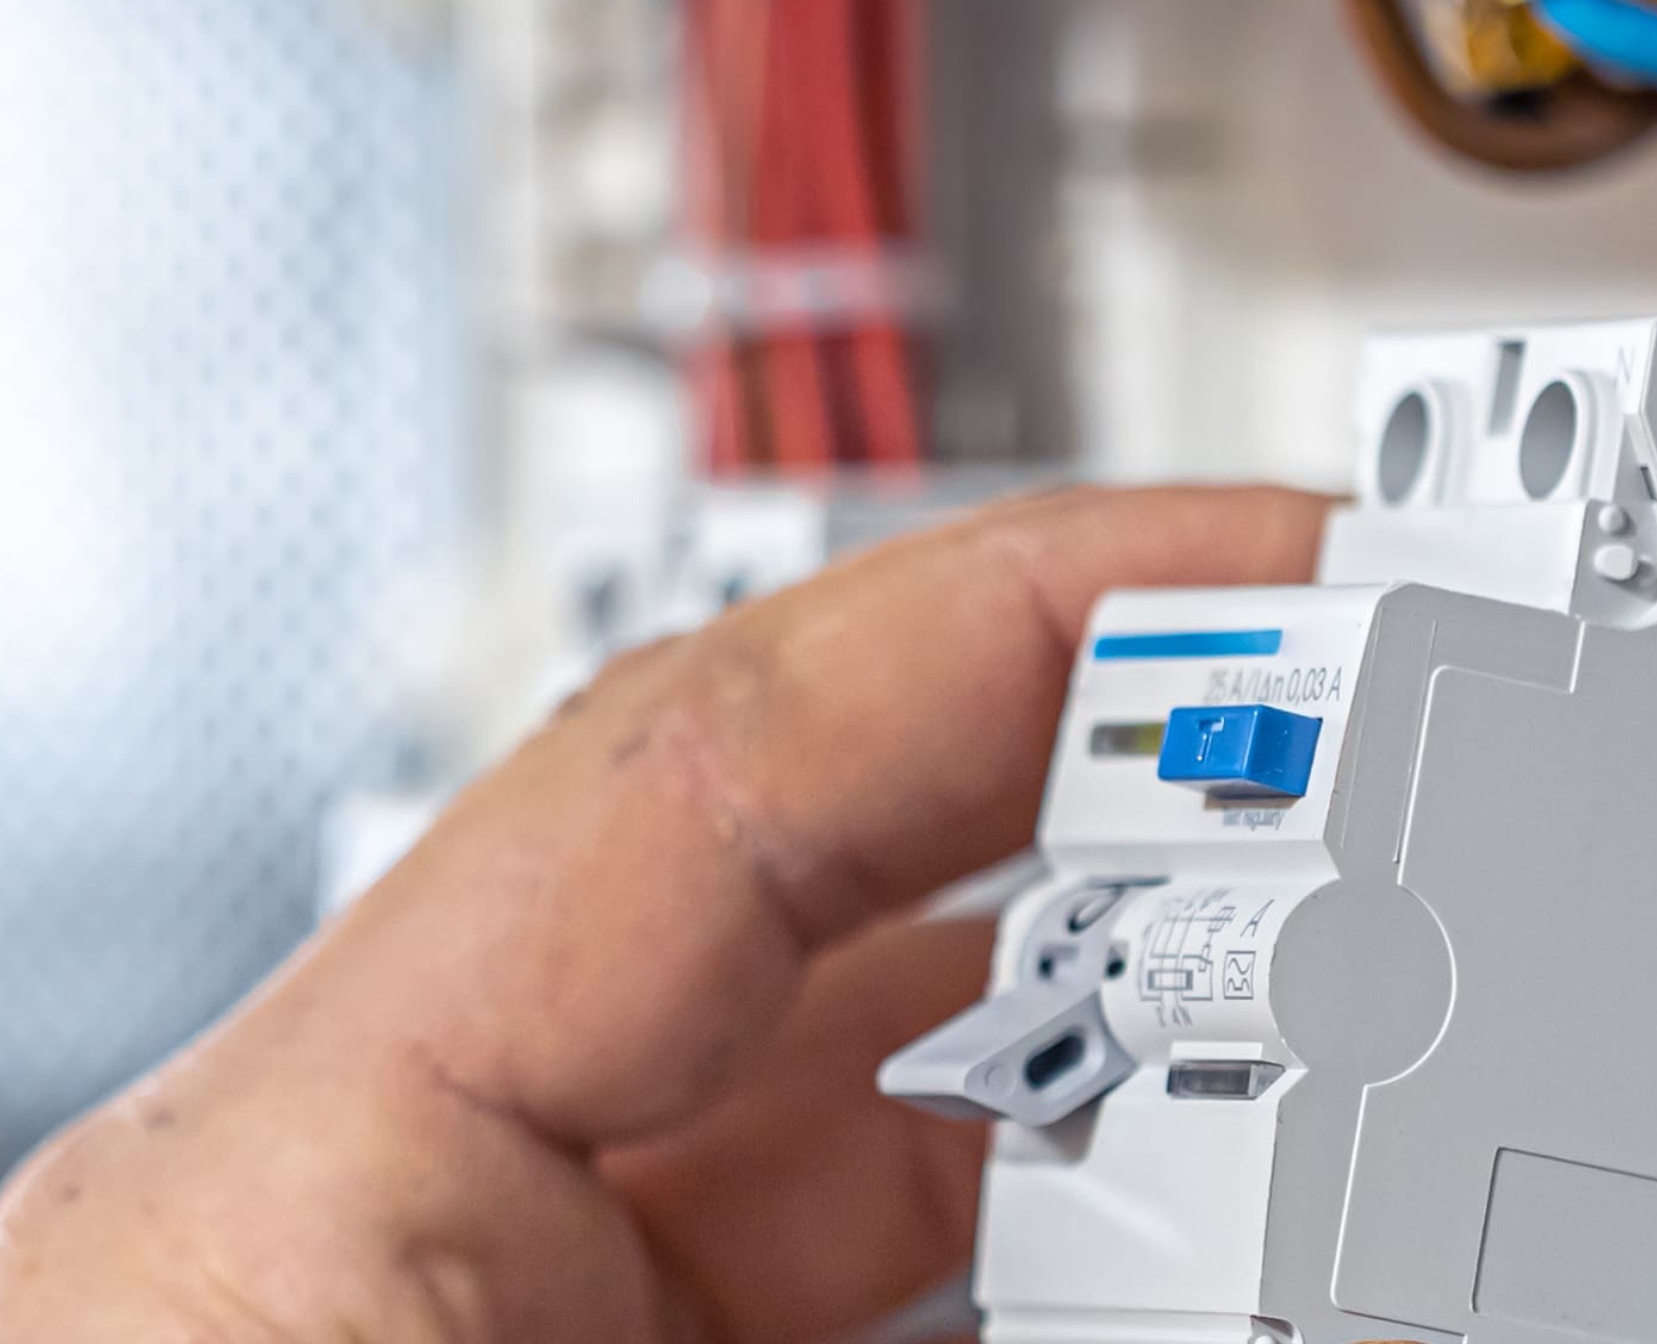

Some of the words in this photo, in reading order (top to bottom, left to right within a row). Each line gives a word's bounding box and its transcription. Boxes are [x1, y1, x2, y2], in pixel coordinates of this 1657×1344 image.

[1612, 343, 1637, 391] N
[1287, 666, 1326, 706] 0,03
[1327, 666, 1342, 702] A
